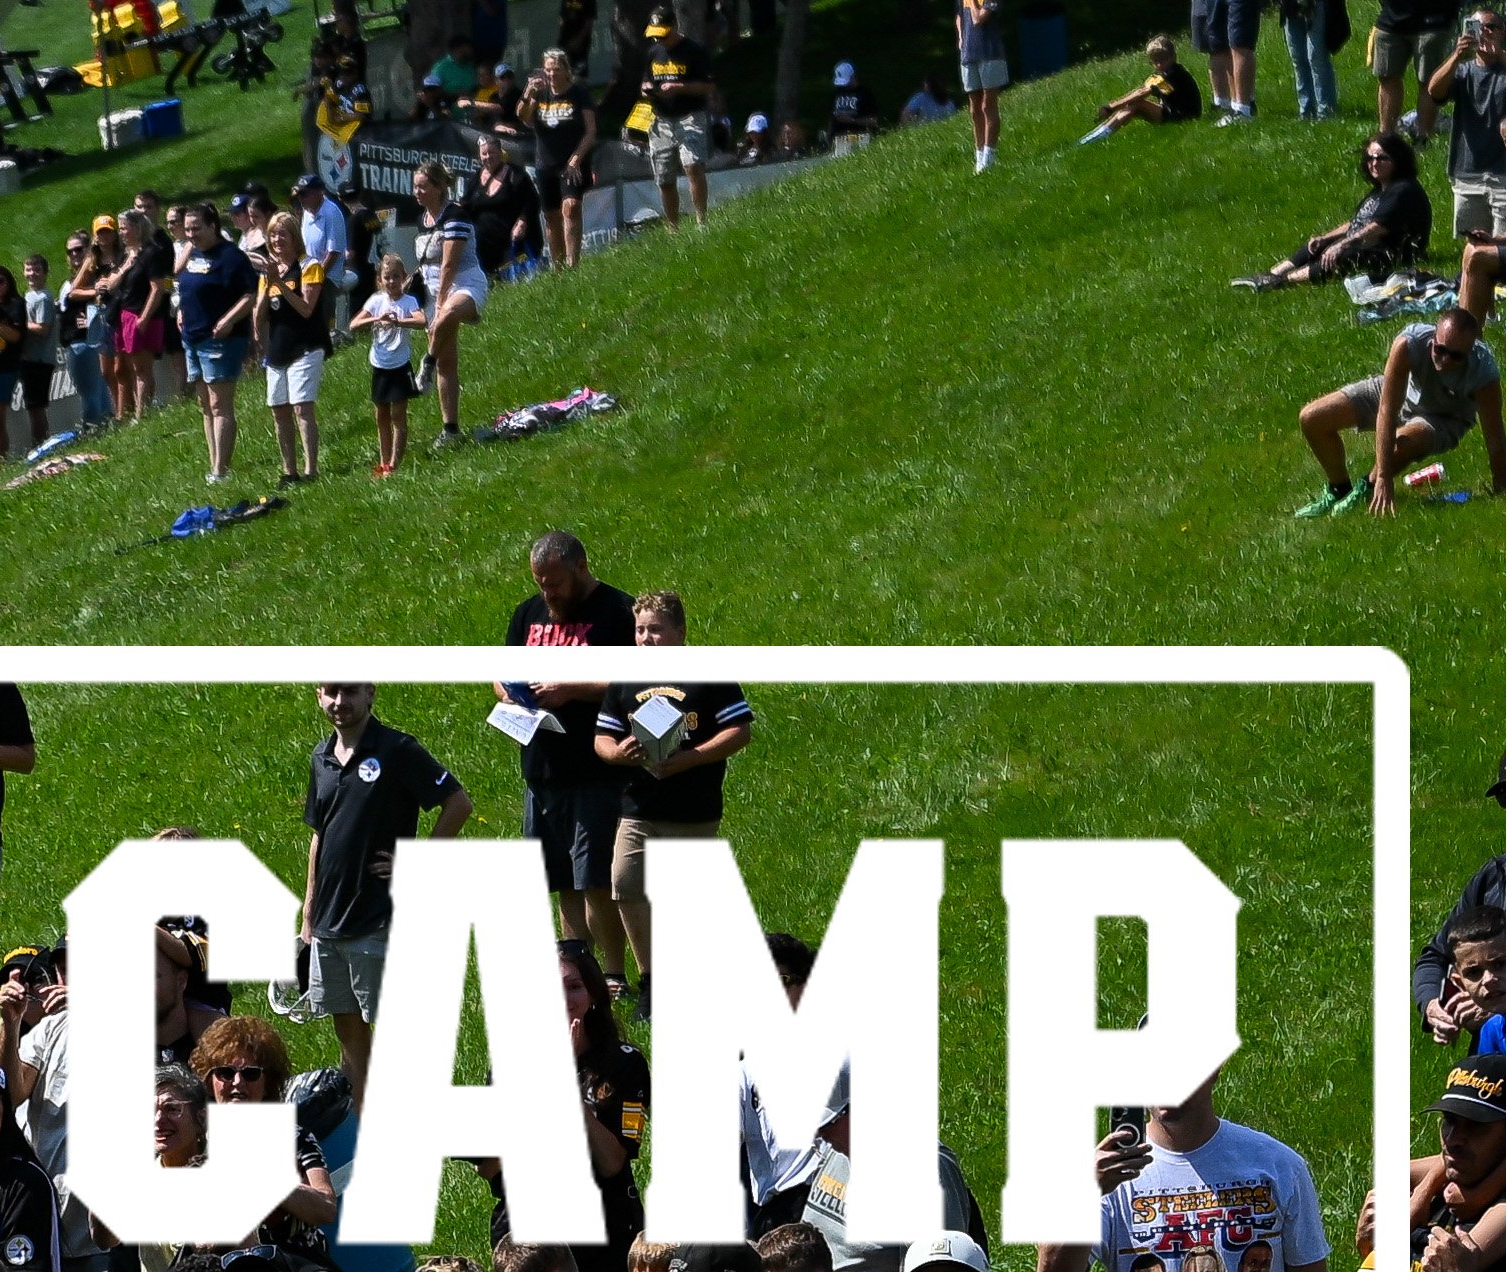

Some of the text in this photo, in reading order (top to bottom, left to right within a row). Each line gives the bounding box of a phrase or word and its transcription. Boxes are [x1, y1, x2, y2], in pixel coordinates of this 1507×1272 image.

[359, 162, 414, 196] TRAIN
[440, 152, 483, 173] STEELE
[1132, 1187, 1277, 1225] STEELERS
